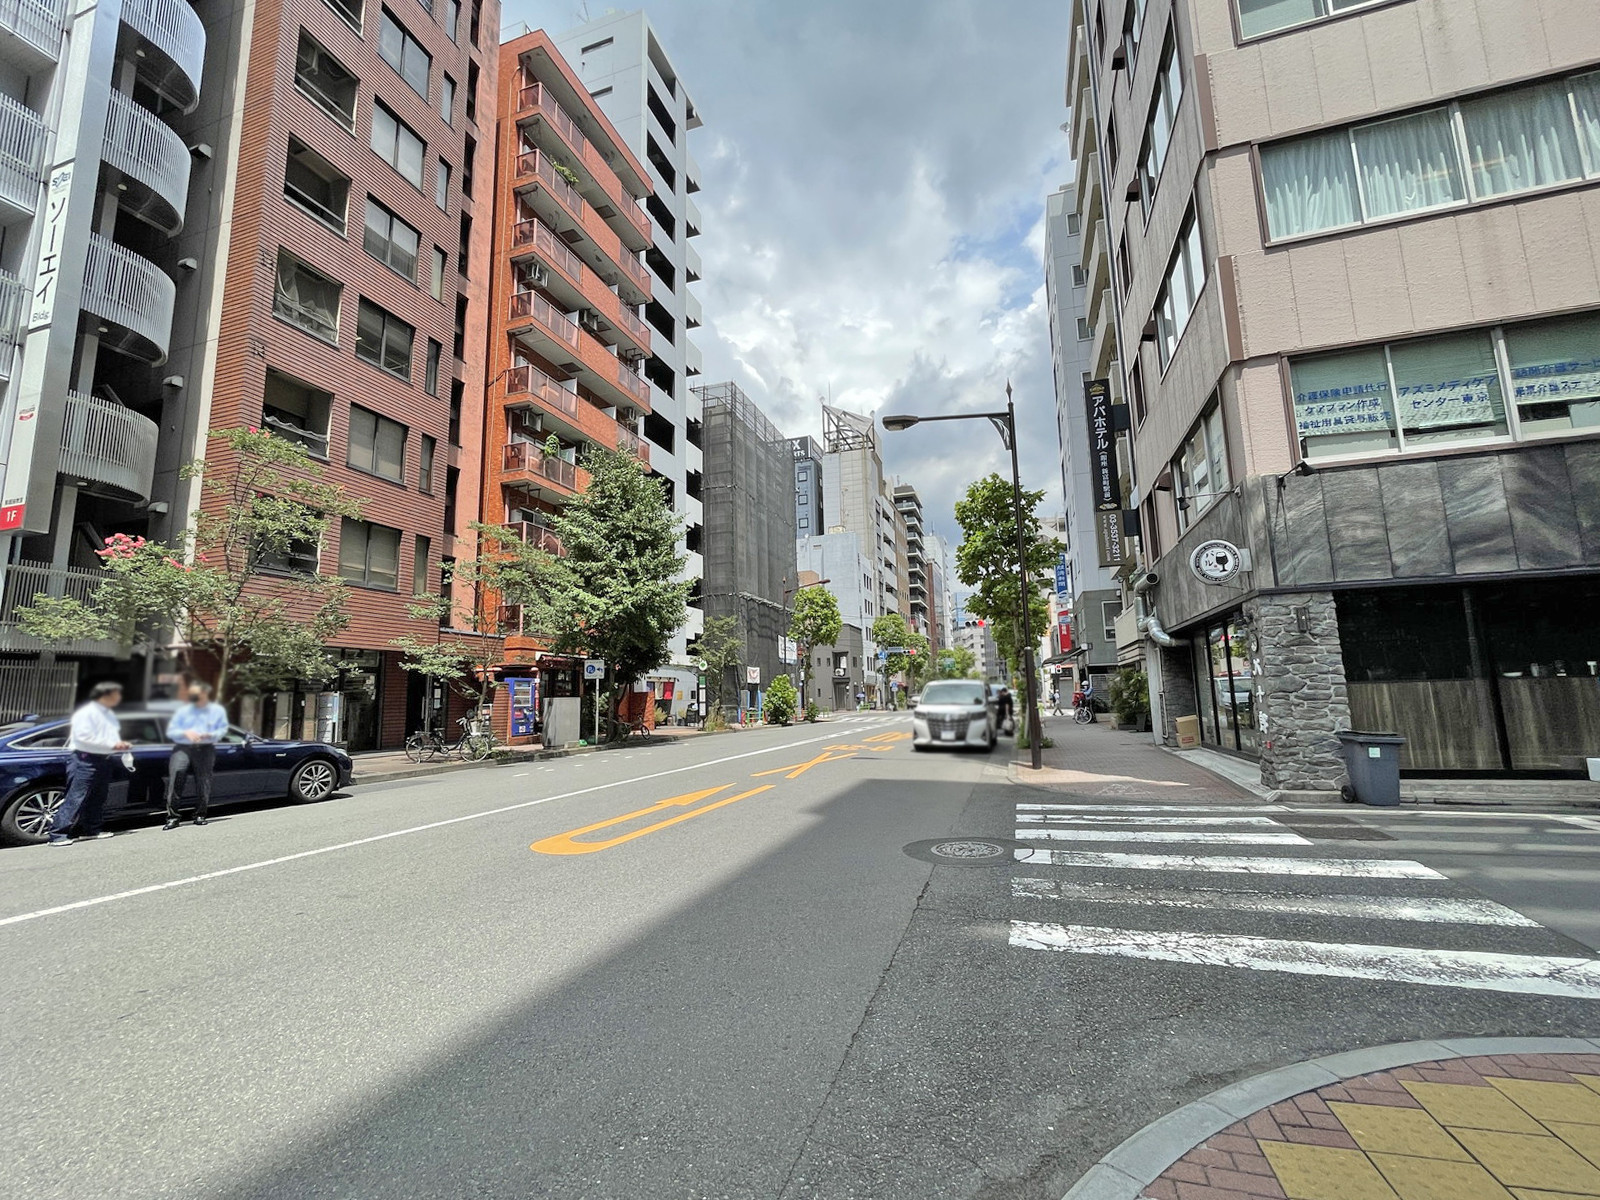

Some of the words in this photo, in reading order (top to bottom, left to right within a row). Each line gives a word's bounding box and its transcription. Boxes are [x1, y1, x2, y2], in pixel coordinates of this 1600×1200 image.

[36, 197, 66, 304] ソーエイ
[1411, 391, 1490, 409] センター東京
[1092, 395, 1109, 450] アパホテル
[6, 510, 18, 522] 1F
